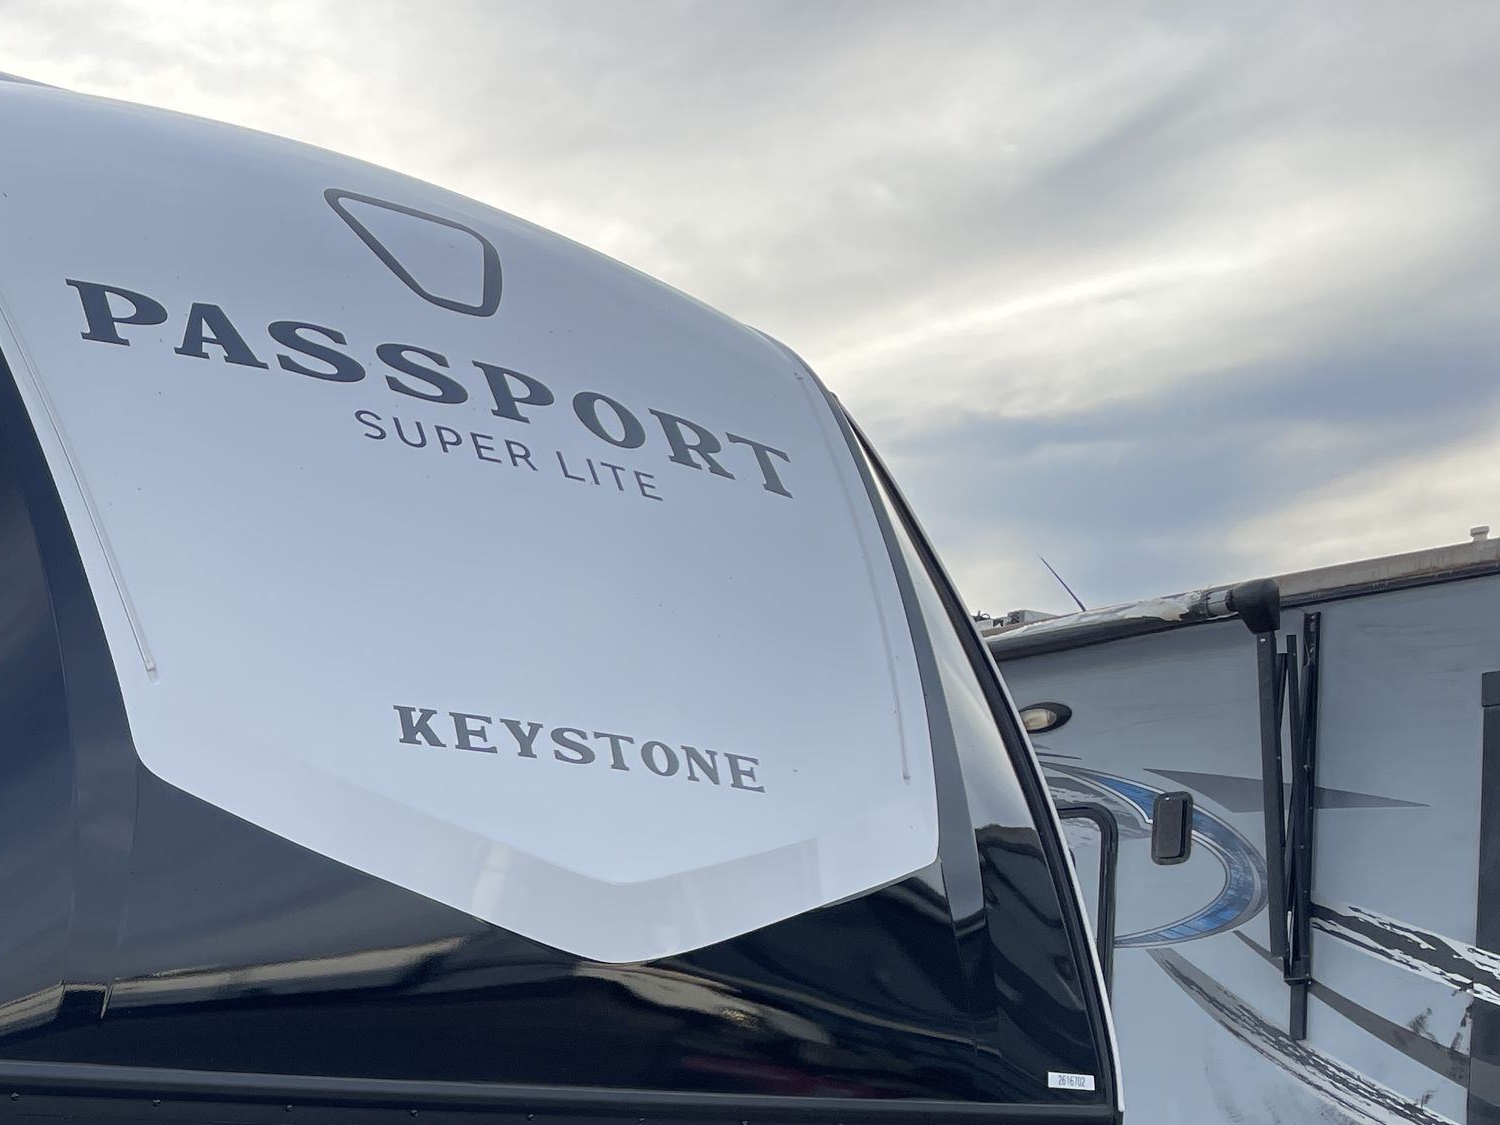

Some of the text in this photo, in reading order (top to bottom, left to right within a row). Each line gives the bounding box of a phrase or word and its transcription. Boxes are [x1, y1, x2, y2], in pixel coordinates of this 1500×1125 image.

[65, 278, 793, 499] PASSPORT
[353, 409, 664, 502] SUPER LITE
[393, 704, 766, 794] KEYSTONE
